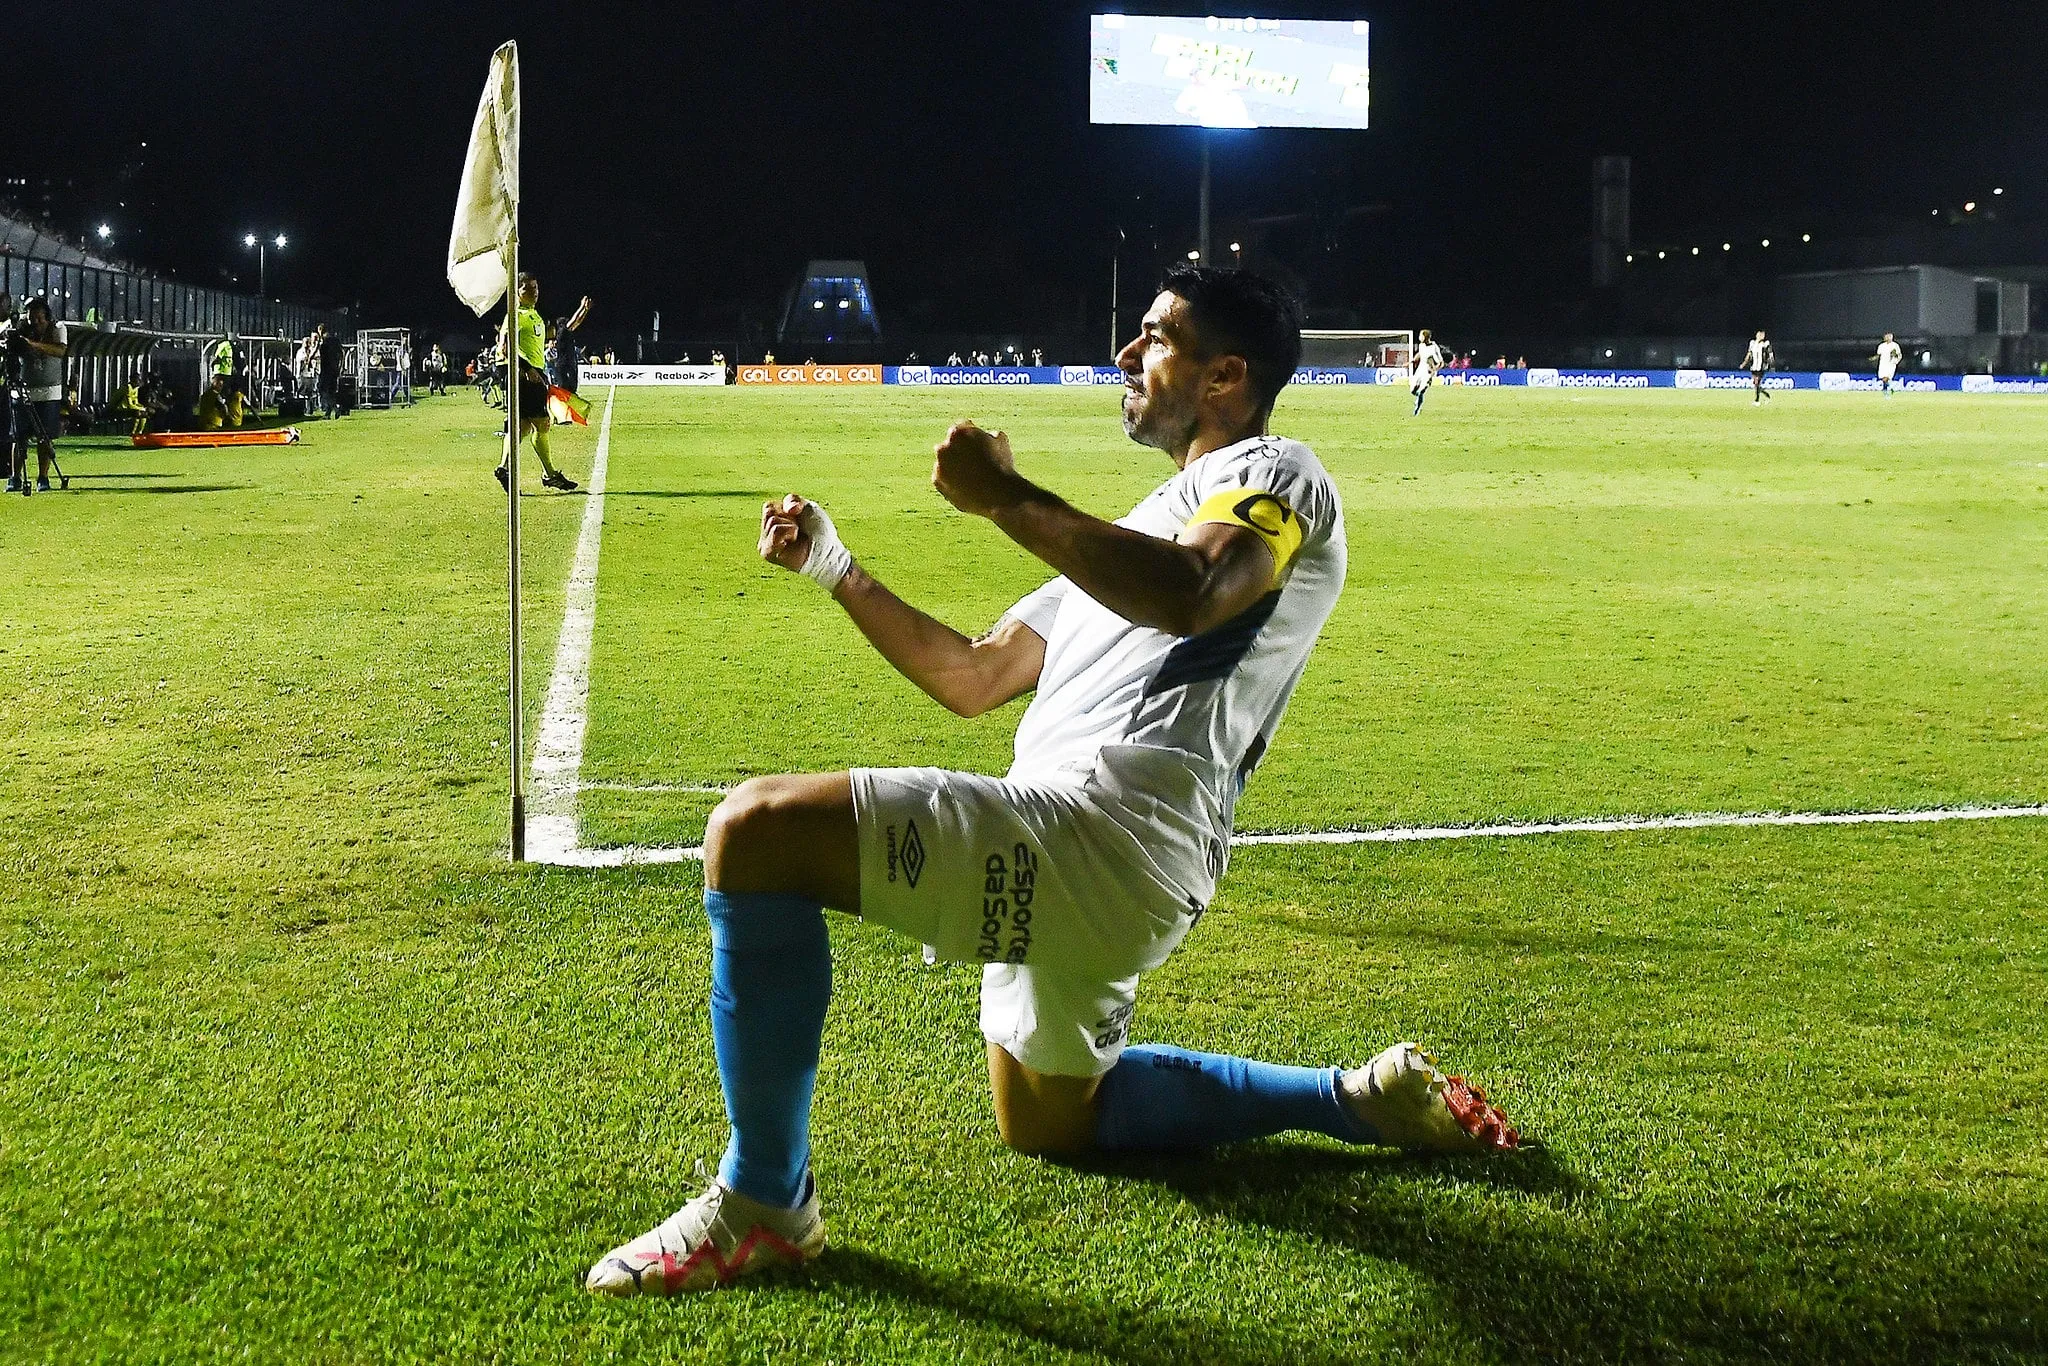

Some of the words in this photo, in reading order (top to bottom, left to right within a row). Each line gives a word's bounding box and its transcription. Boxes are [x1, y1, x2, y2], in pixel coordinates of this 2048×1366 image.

[583, 371, 624, 380] Reebok
[655, 371, 695, 380] Reebok
[742, 368, 773, 382] GOL
[777, 368, 808, 382] GOL
[813, 368, 843, 382] GOL
[847, 368, 878, 382] GOL
[1232, 493, 1291, 537] C
[886, 825, 898, 883] umbro
